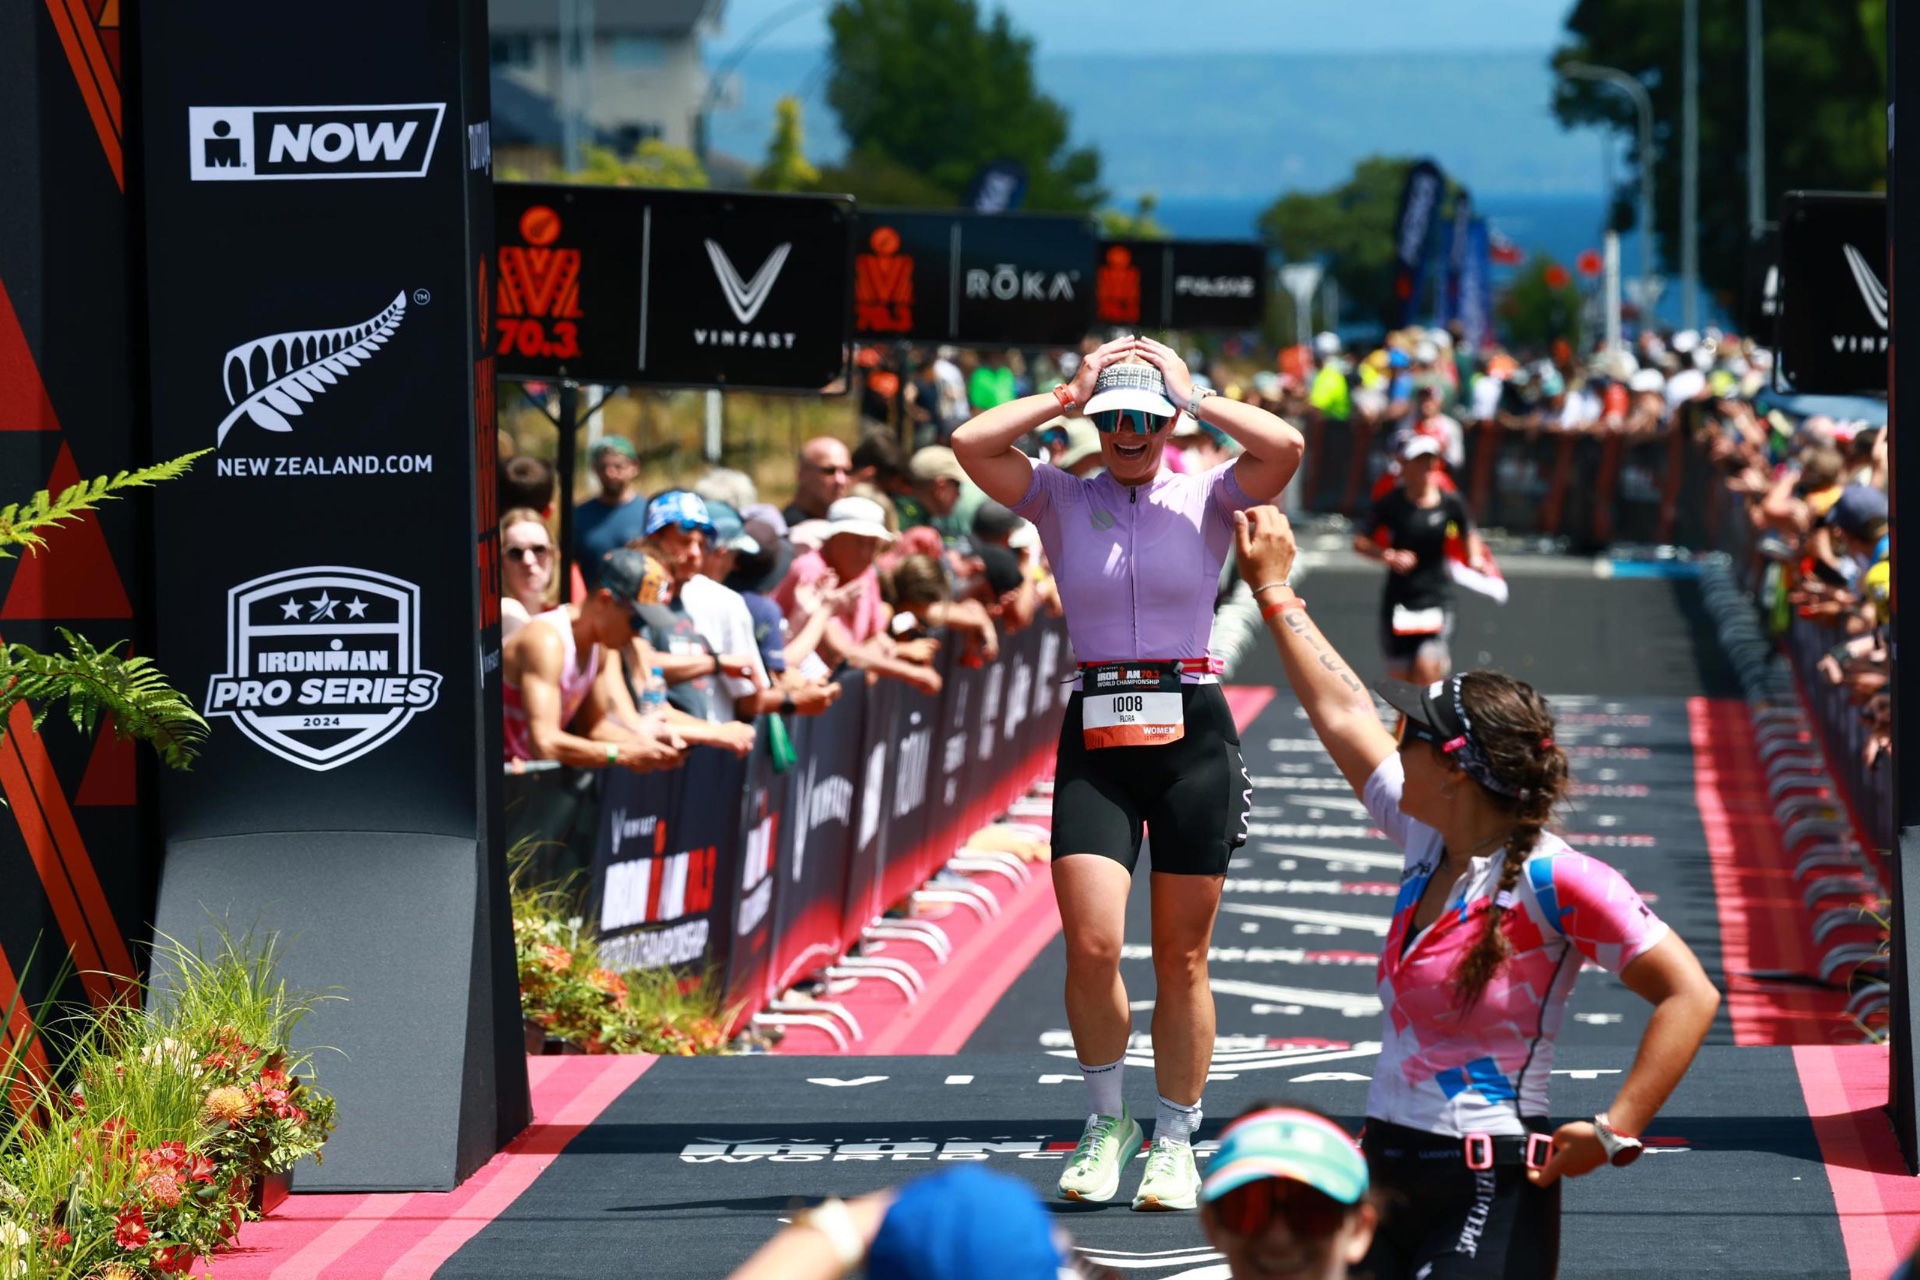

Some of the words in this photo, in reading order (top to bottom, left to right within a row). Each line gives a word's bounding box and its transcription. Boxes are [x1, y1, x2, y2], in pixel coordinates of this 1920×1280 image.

[268, 122, 419, 163] NOW
[495, 319, 582, 359] 70.3
[694, 328, 797, 350] VINFAST
[1832, 334, 1888, 353] VINF
[217, 456, 270, 477] NEW
[275, 454, 433, 476] ZEALAND.COM
[258, 638, 391, 674] IRONMAN
[212, 679, 293, 709] PRO
[297, 677, 434, 706] SERIES
[1097, 680, 1116, 688] WORLD
[1116, 678, 1160, 686] CHAMPIONSHIP
[1112, 695, 1143, 713] 1008
[303, 717, 341, 727] 2024
[1143, 726, 1175, 735] WOMEN
[679, 1153, 991, 1164] WORLD
